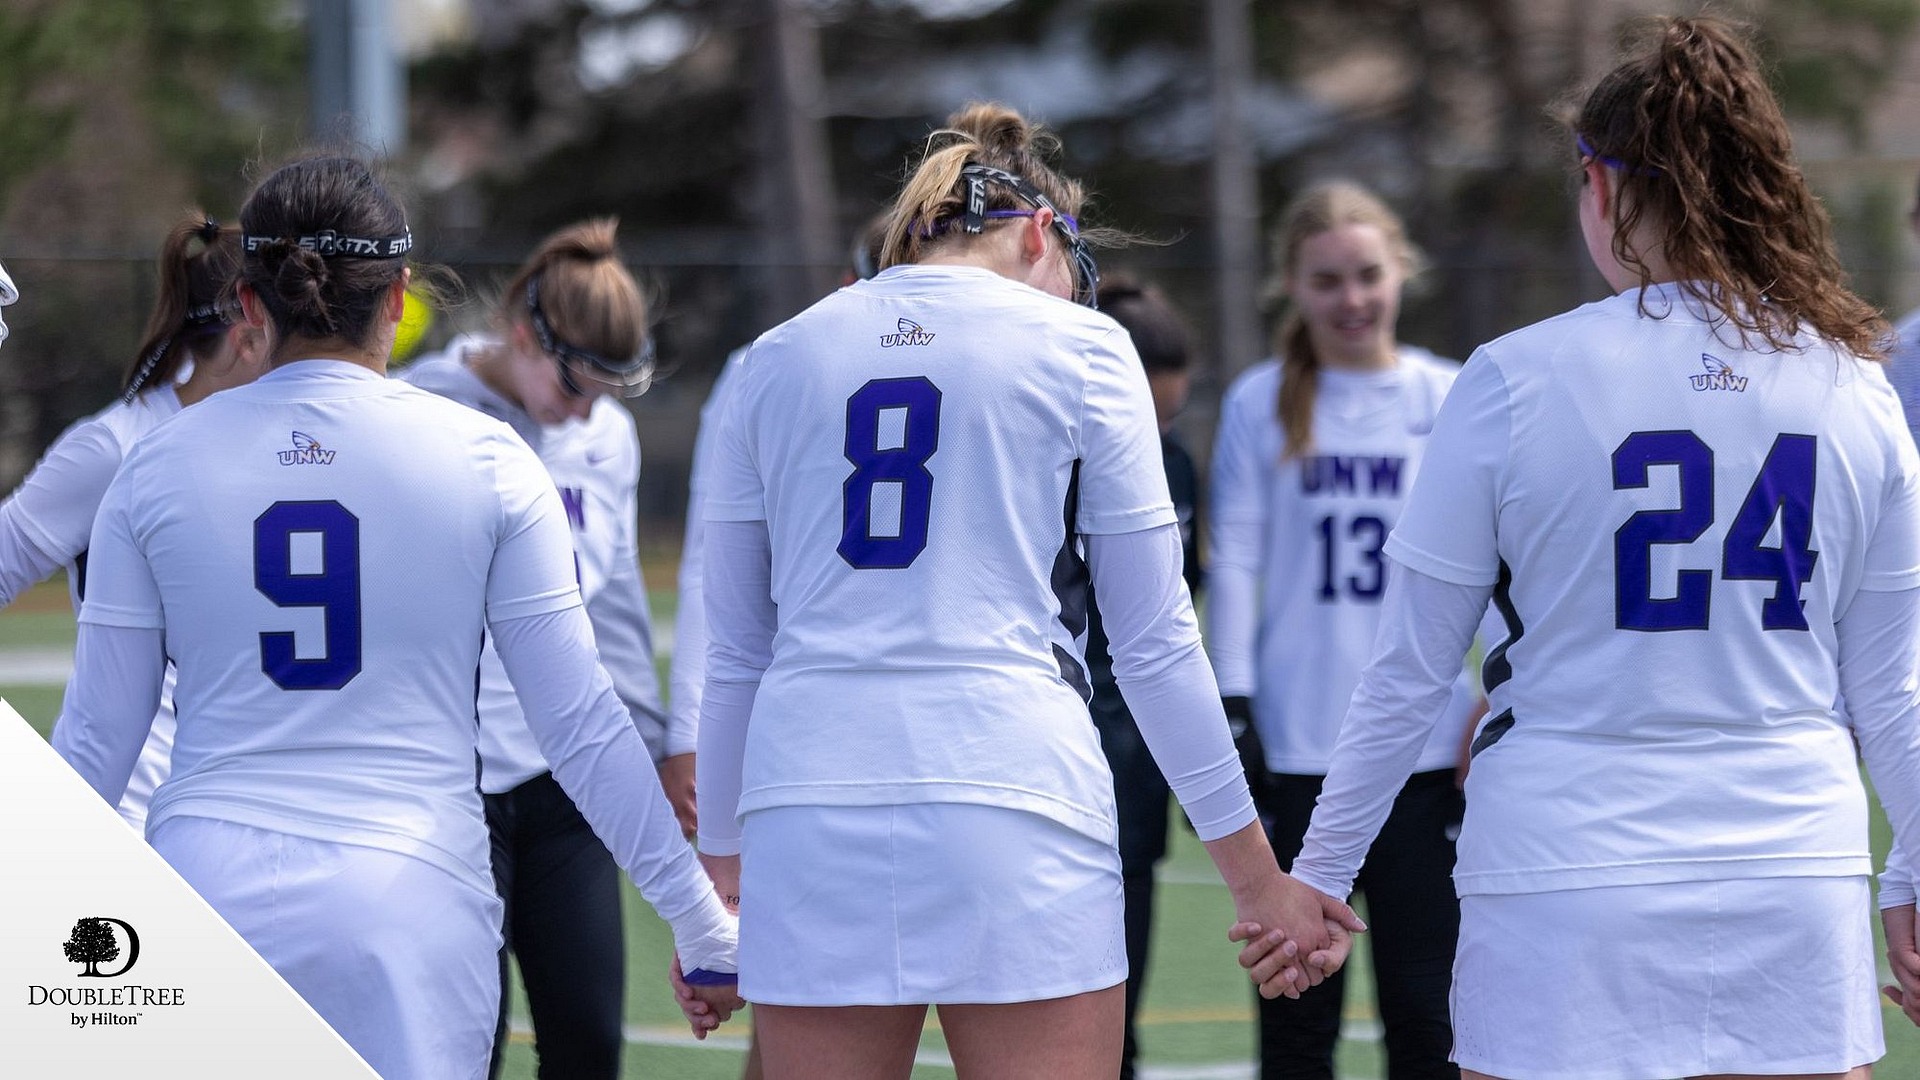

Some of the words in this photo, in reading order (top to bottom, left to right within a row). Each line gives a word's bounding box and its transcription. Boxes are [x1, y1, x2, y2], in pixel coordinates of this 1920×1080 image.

[969, 178, 986, 217] STX
[881, 332, 936, 348] UNW
[1689, 373, 1749, 393] UNW
[277, 449, 336, 466] UNW
[837, 376, 942, 569] 8
[1301, 454, 1406, 497] UNW
[1612, 430, 1819, 632] 24
[1315, 514, 1386, 604] 13
[254, 500, 362, 690] 9
